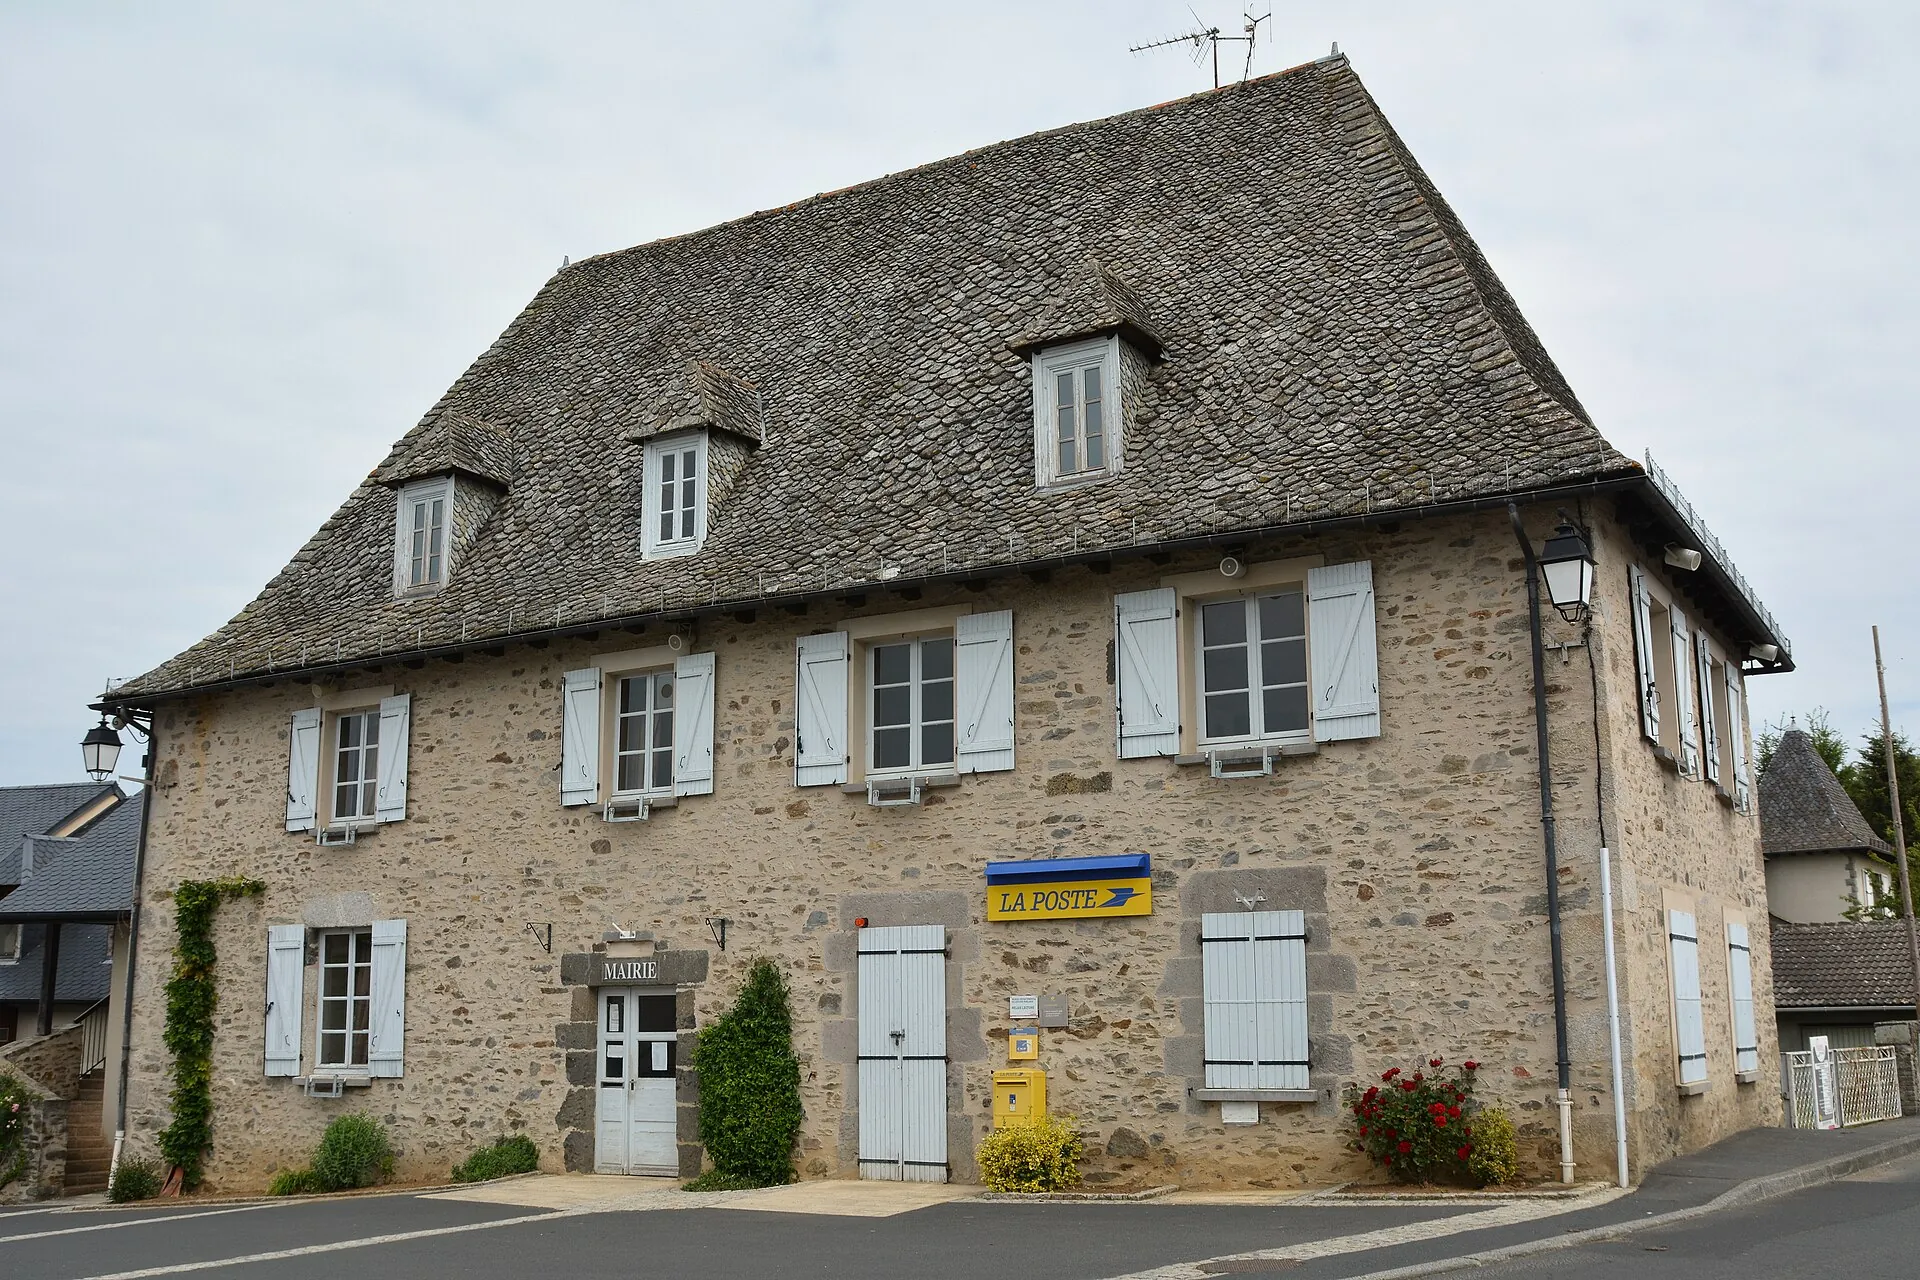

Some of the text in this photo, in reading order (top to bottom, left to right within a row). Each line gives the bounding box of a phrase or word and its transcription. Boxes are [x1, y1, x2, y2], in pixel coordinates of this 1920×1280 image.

[999, 889, 1098, 912] LA POSTE
[604, 962, 657, 979] MAIRIE
